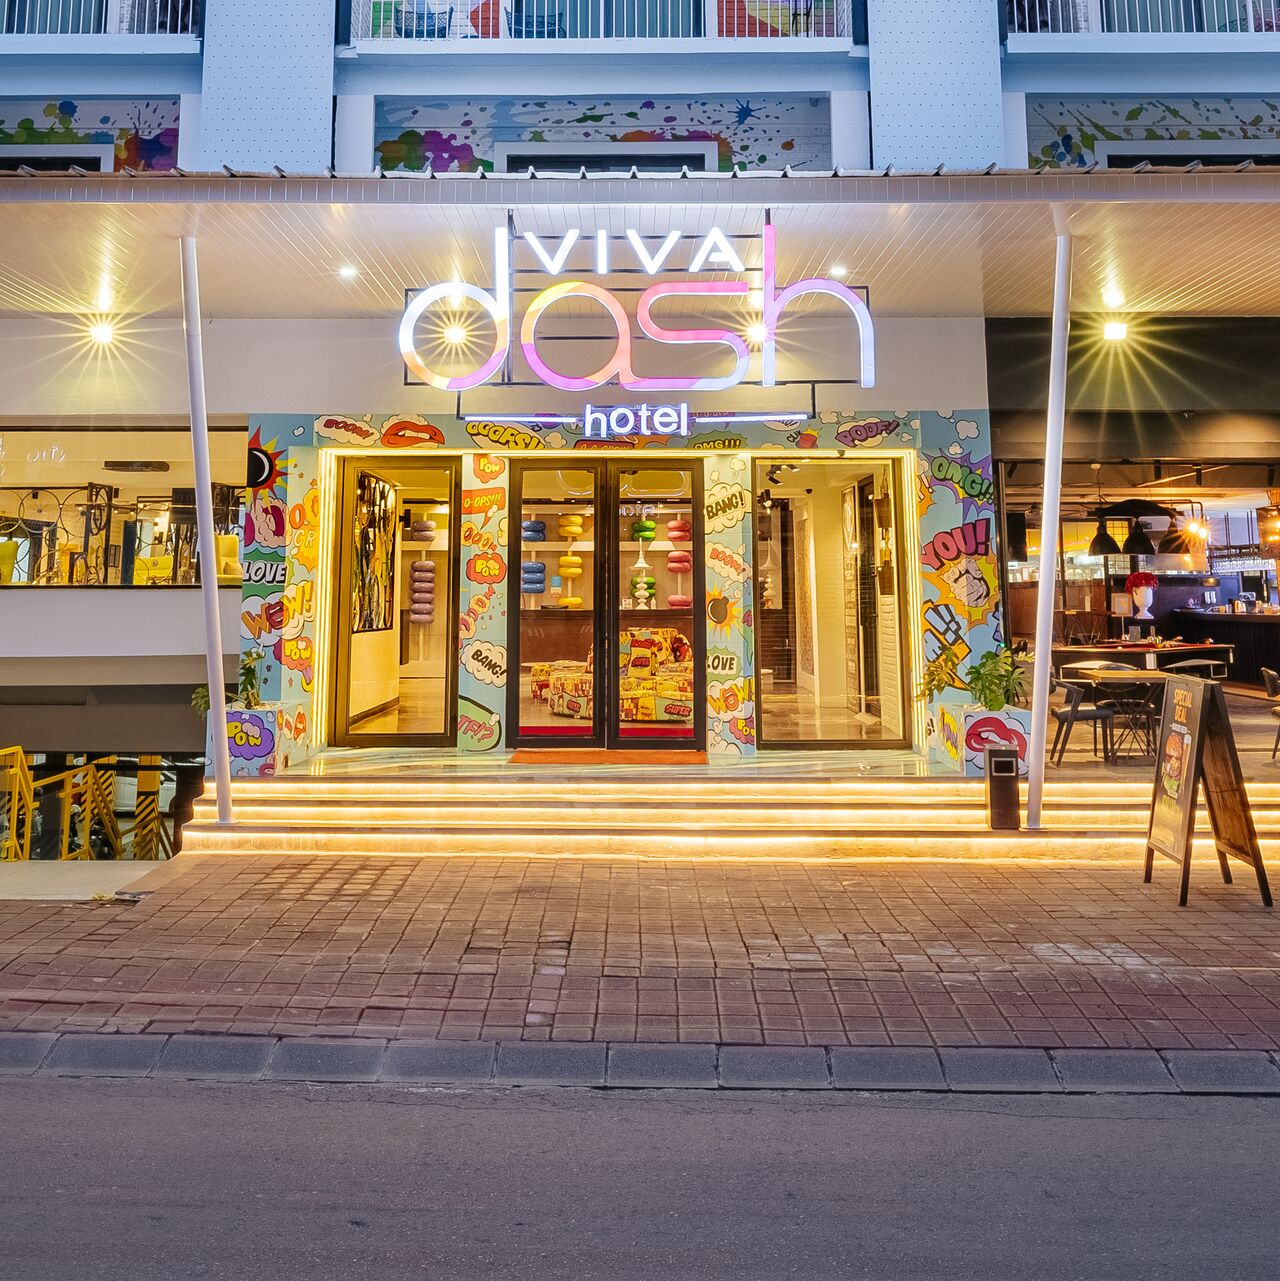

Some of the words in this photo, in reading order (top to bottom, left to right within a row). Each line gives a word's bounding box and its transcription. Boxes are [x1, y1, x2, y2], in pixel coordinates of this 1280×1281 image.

[523, 226, 745, 276] VIVA
[399, 224, 876, 391] dash
[585, 403, 688, 437] hotel
[705, 490, 745, 520] BANG!
[920, 518, 991, 570] YOU!
[471, 648, 507, 679] BANG!
